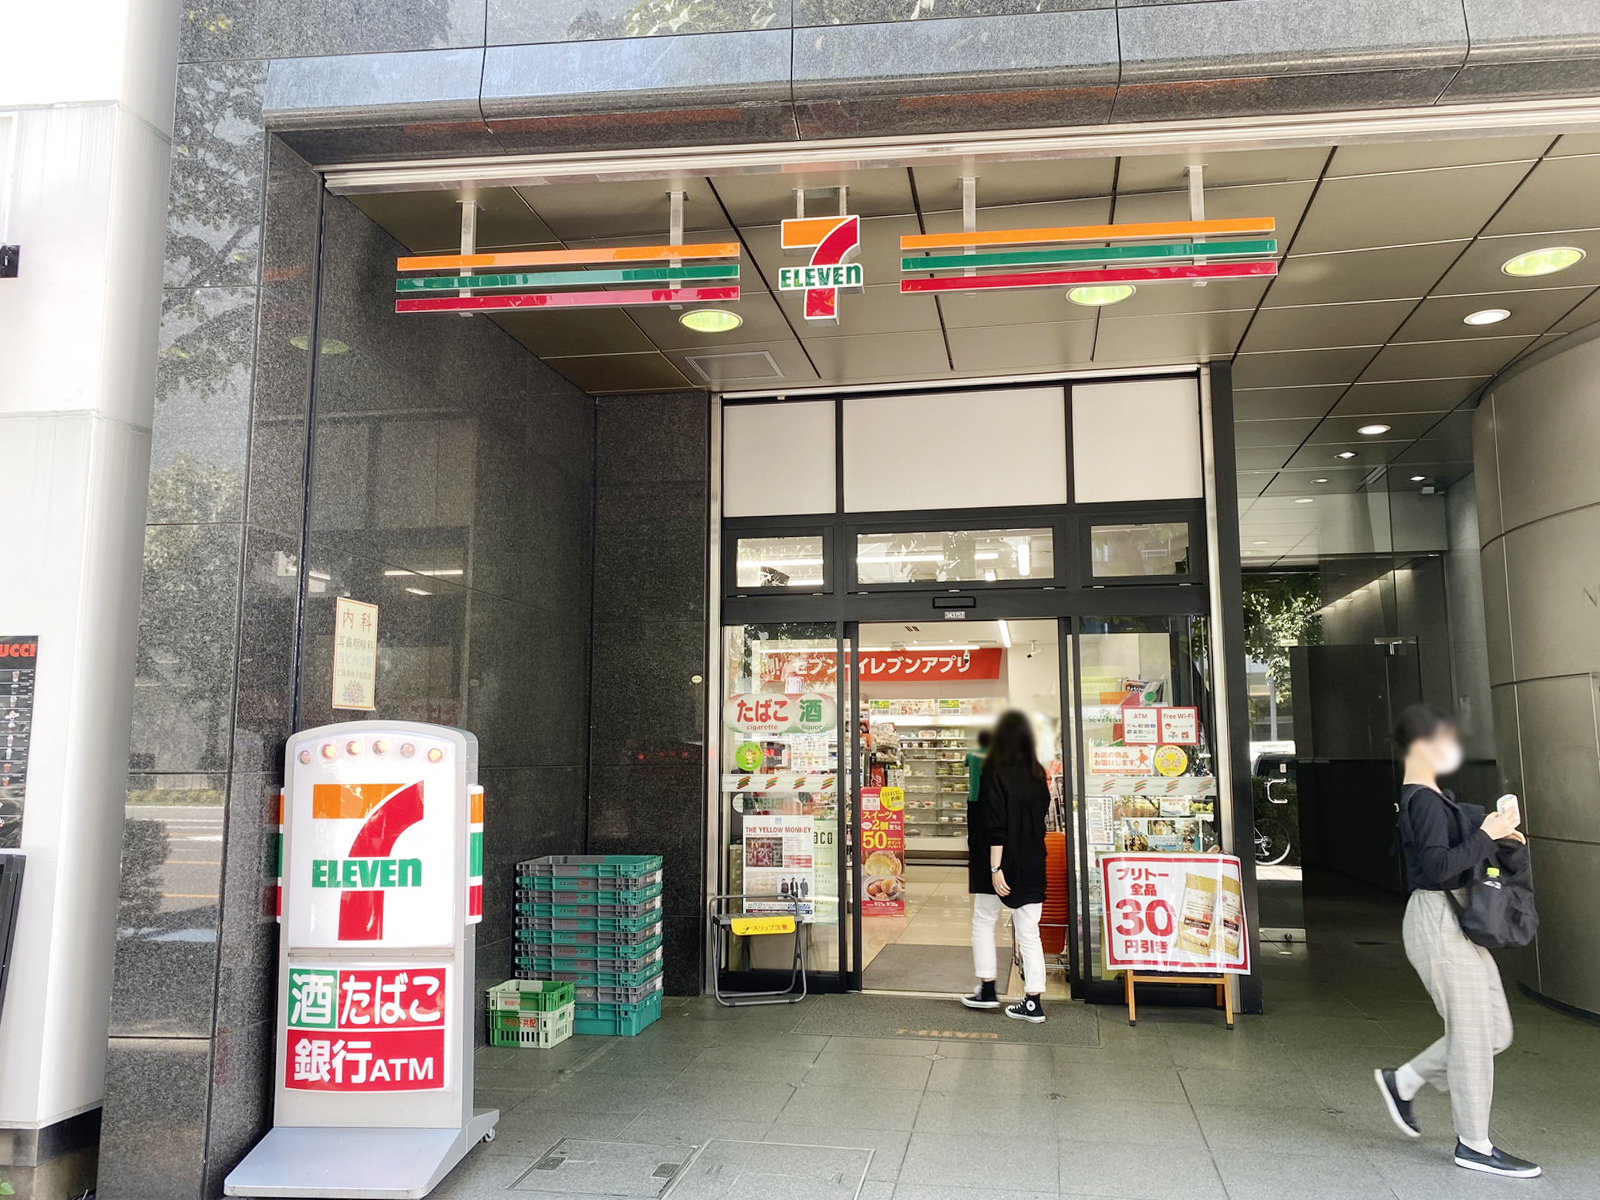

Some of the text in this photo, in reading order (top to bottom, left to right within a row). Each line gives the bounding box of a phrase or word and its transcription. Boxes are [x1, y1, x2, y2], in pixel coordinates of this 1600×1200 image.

[342, 608, 372, 633] 内科
[737, 699, 822, 723] たばこ 酒
[801, 723, 822, 731] liquor
[759, 826, 783, 834] YELLOW
[785, 826, 812, 834] MONKEY
[862, 831, 888, 849] 50
[1130, 883, 1157, 897] 全品
[1115, 898, 1176, 937] 30
[1124, 939, 1169, 954] 円引き
[290, 972, 441, 1025] 酒 たばこ
